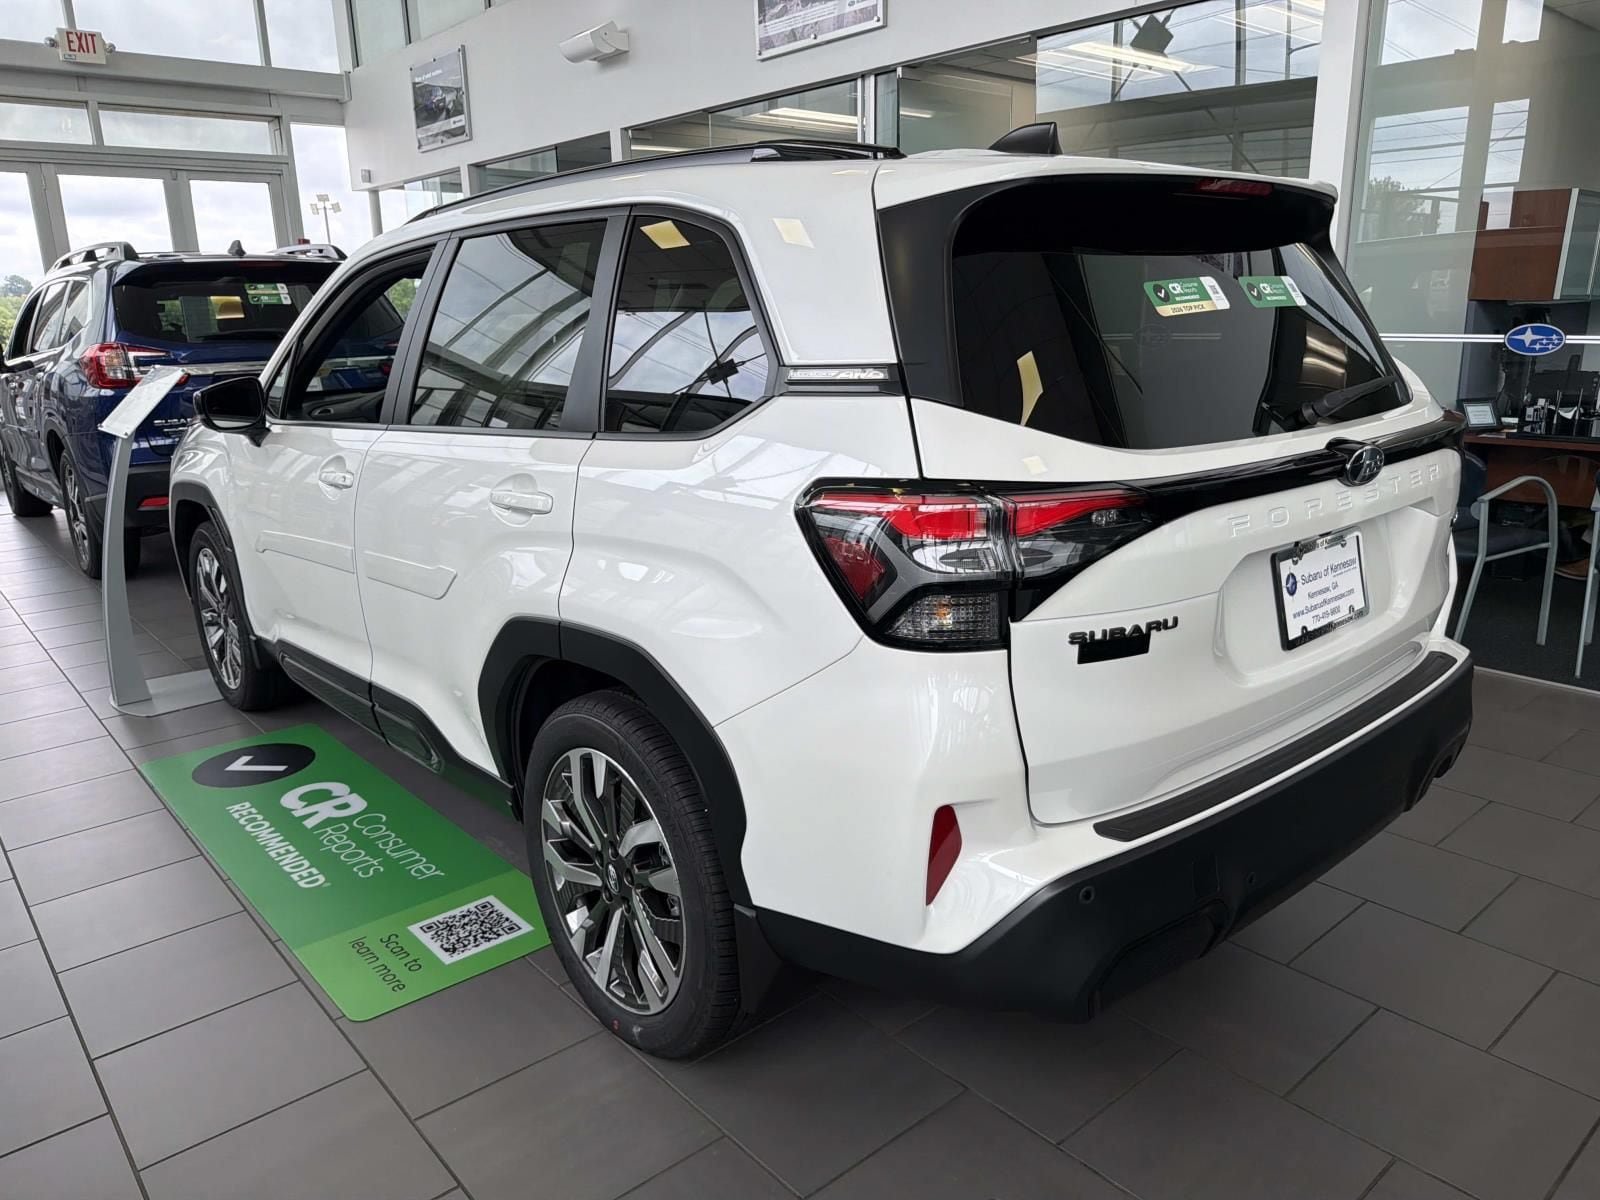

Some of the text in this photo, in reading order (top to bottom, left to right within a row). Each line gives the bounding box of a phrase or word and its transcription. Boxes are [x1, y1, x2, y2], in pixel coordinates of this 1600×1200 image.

[66, 31, 96, 54] EXIT
[1169, 283, 1184, 294] CR
[1228, 464, 1440, 538] FORESTER
[1300, 571, 1323, 586] Subaru
[1323, 566, 1330, 579] of
[1330, 557, 1357, 575] Kennesaw
[1331, 581, 1339, 591] GA
[1068, 615, 1179, 645] SUBARU
[280, 781, 368, 829] CR
[313, 823, 384, 878] Reports
[352, 813, 445, 879] Consumer
[349, 936, 406, 993] learn more
[379, 933, 422, 973] Scan to
